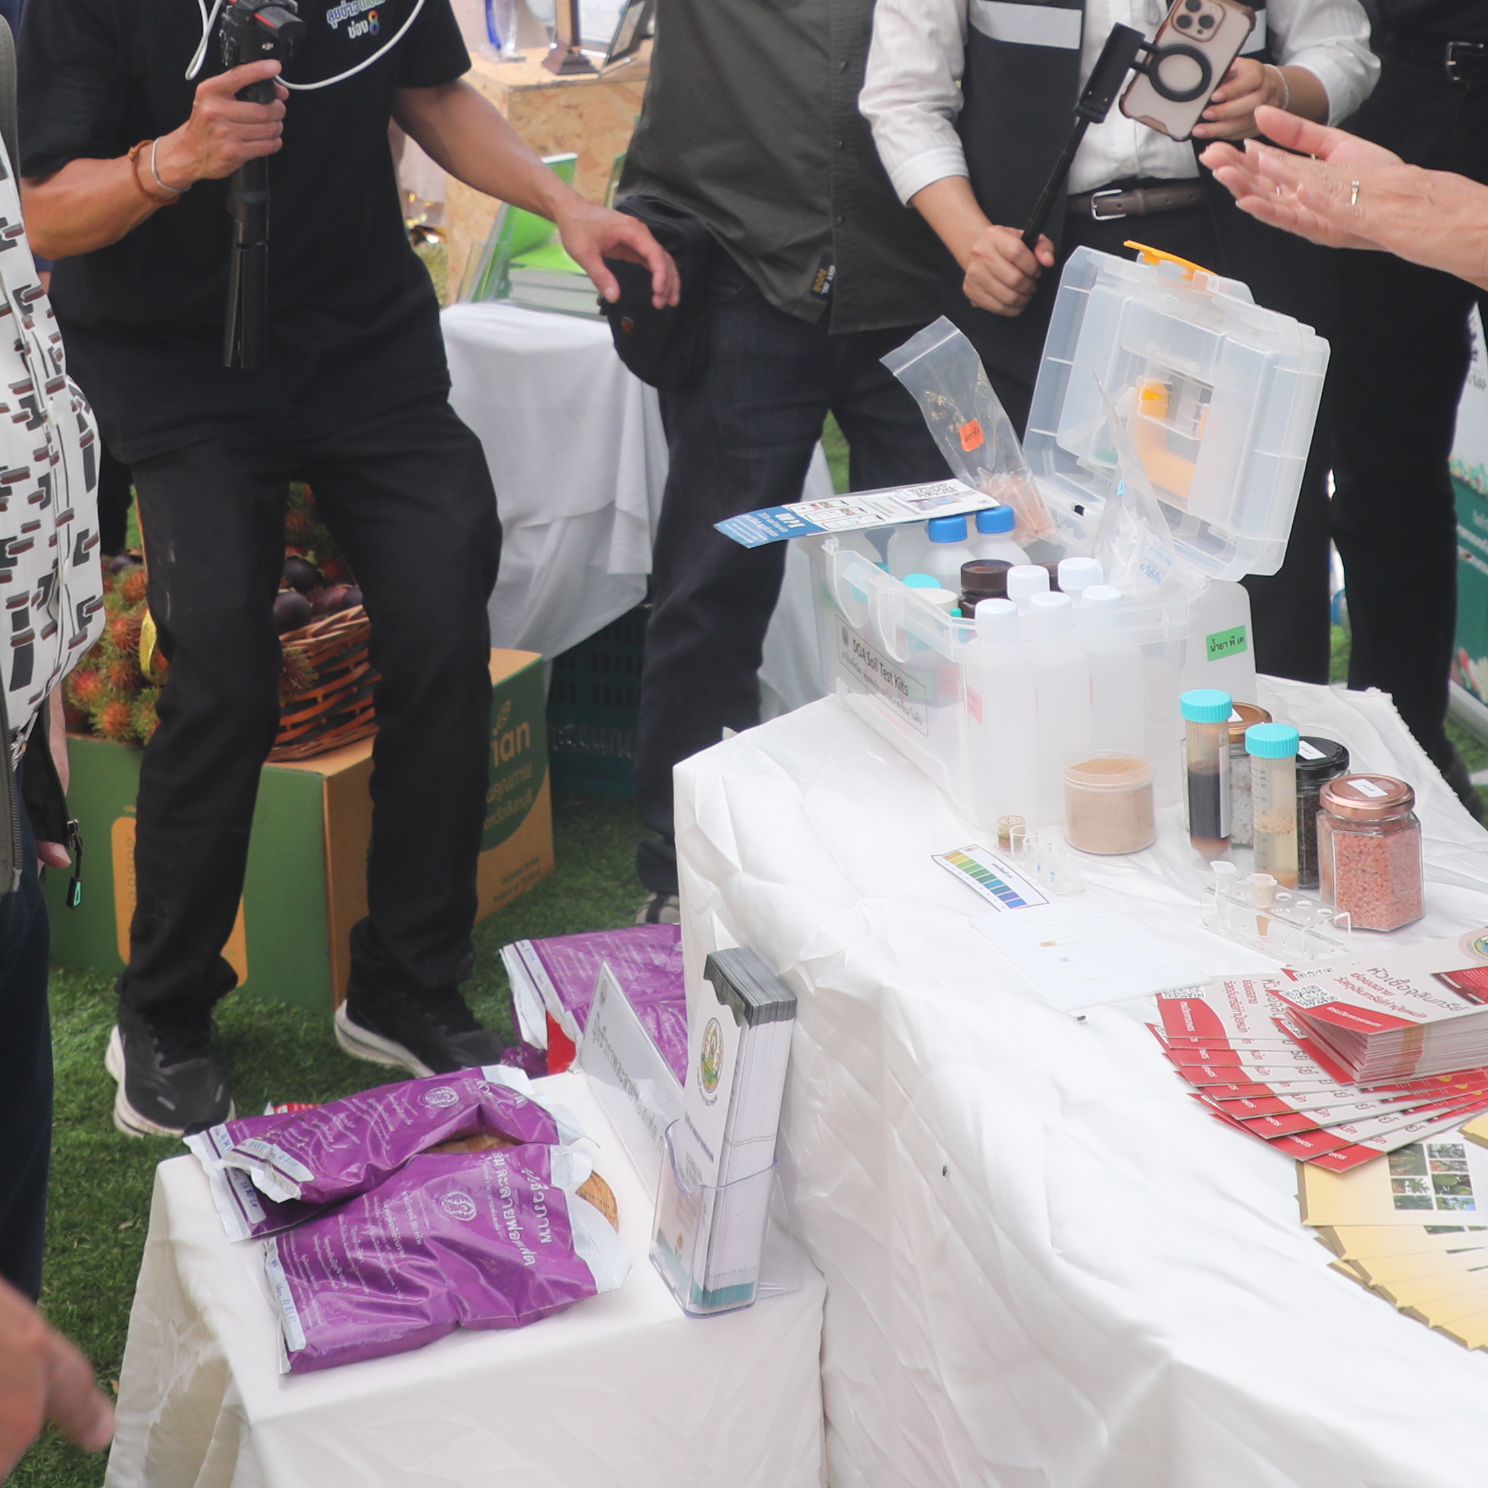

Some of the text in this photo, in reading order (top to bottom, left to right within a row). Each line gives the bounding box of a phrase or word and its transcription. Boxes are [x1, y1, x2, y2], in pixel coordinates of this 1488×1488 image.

[348, 10, 380, 40] ช่อง 8
[852, 638, 909, 696] DOA Soil Test Kits
[491, 722, 531, 767] ian
[1366, 966, 1471, 1012] หัวเชื้อจุลินทรีย์
